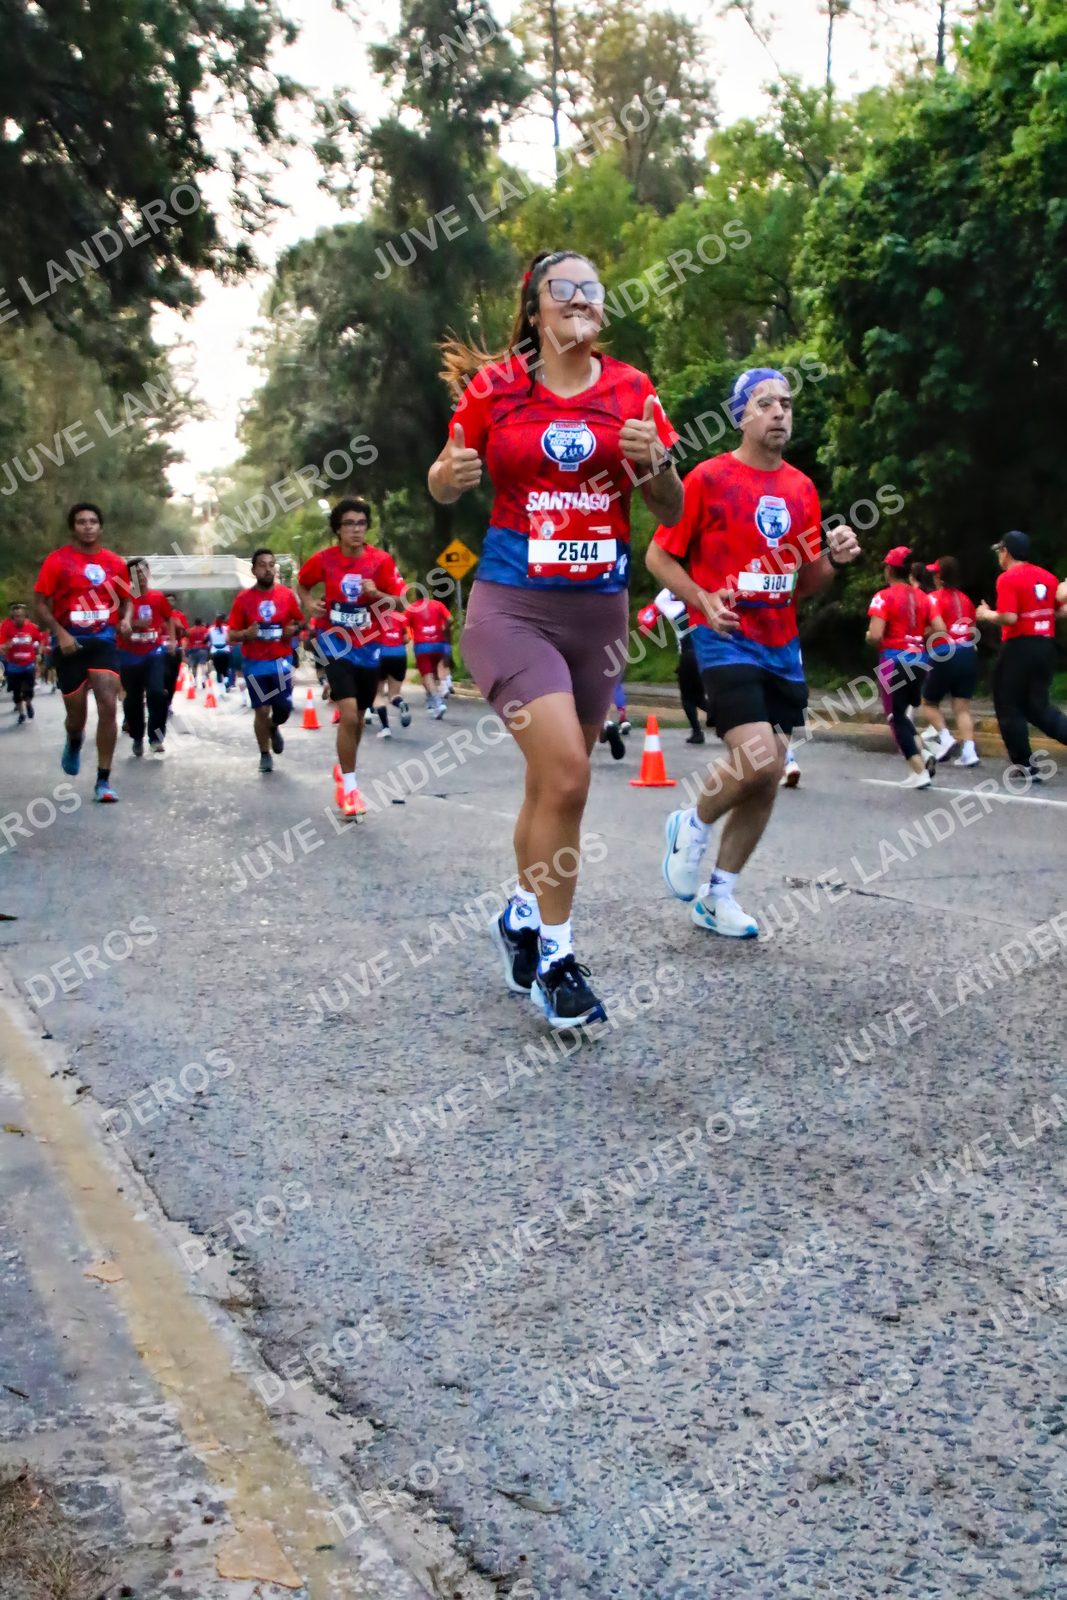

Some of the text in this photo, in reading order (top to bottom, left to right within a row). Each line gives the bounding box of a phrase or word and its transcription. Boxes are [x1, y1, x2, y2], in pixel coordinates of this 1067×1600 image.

[526, 488, 609, 512] SANTIAGO
[558, 542, 599, 561] 2544
[763, 576, 787, 590] 3104
